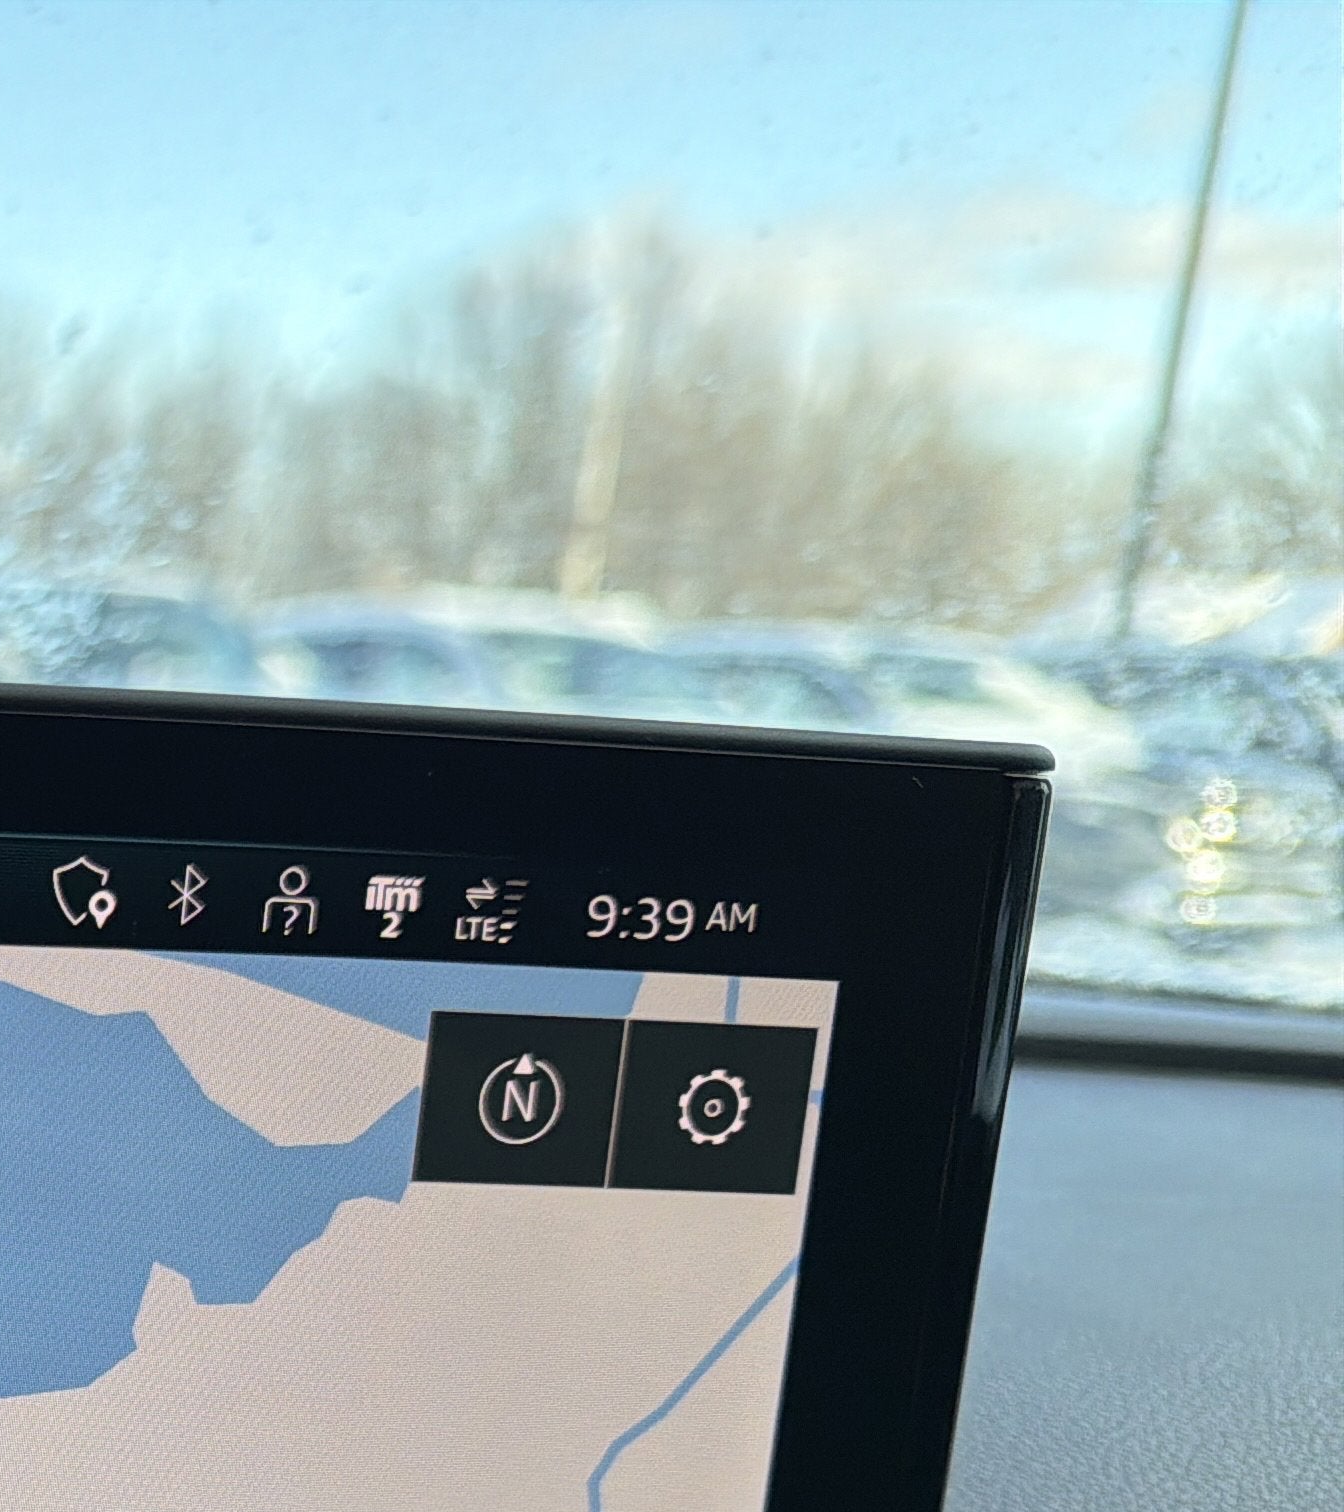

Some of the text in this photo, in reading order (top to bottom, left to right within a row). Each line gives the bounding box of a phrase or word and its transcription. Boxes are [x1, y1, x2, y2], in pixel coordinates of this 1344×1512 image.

[379, 911, 403, 938] 2
[454, 916, 501, 941] LTE
[585, 894, 759, 942] 9:39 AM
[501, 1079, 540, 1122] N
